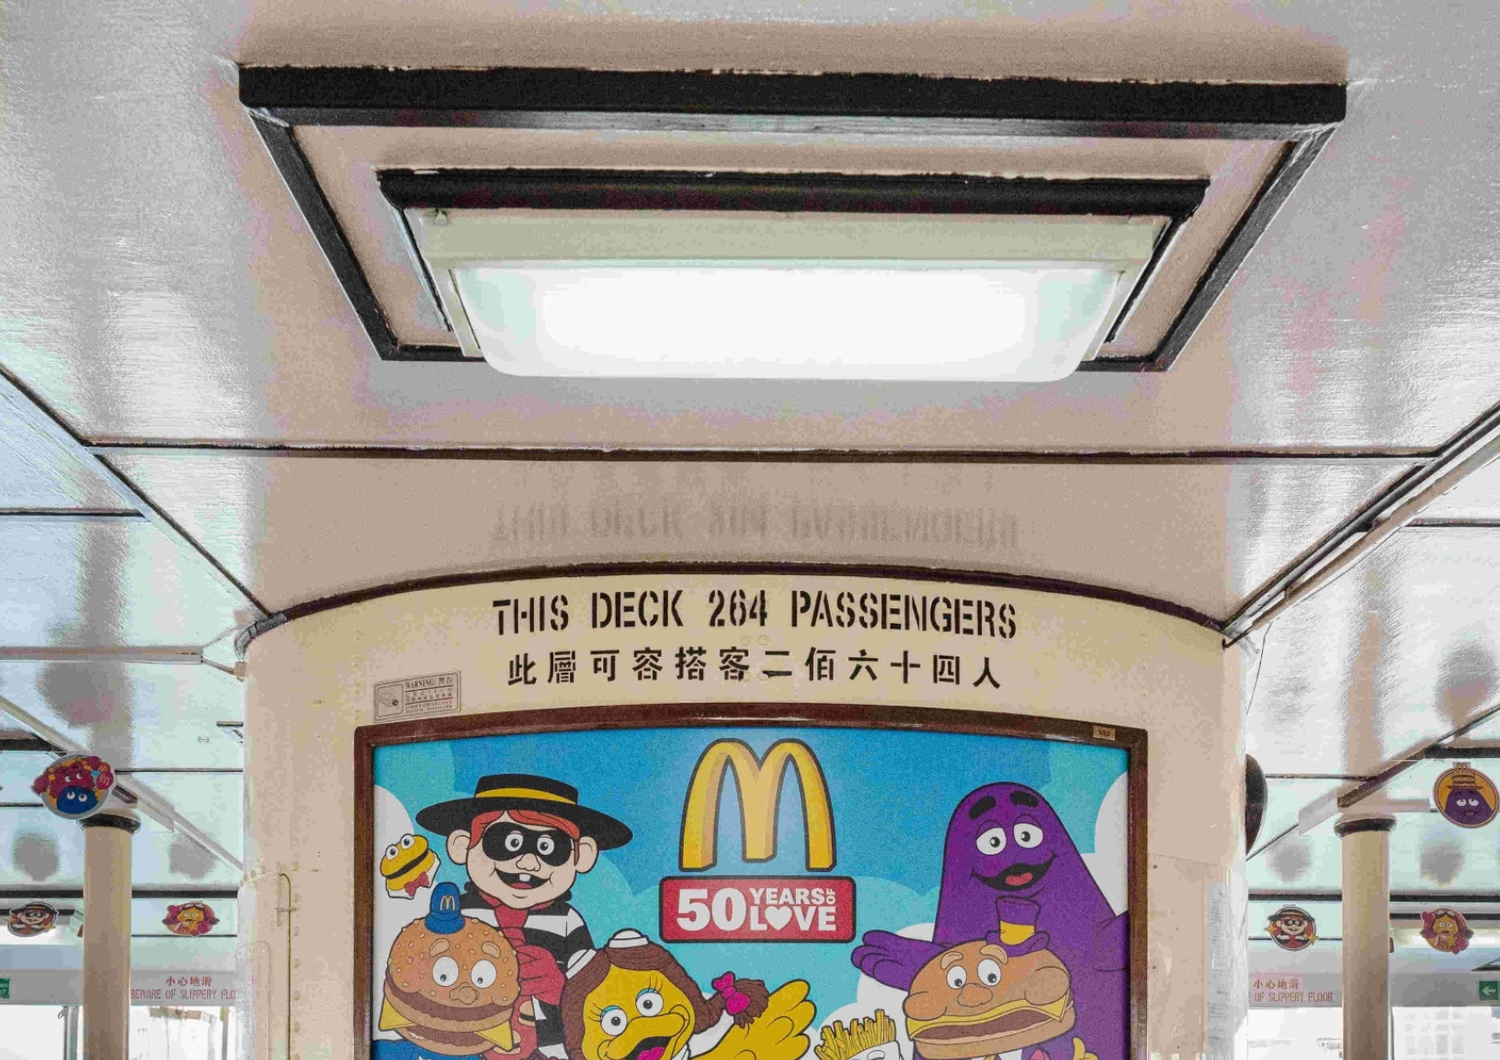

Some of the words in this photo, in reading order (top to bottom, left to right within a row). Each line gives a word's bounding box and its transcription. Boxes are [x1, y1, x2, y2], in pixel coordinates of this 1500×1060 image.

[493, 594, 569, 635] THIS
[591, 590, 684, 628] DECK
[708, 590, 767, 627] 264
[791, 590, 1017, 639] PASSENGERS
[676, 887, 747, 932] 50
[749, 887, 826, 905] YEARS
[165, 976, 213, 987] 小心地滑
[165, 989, 176, 1000] OF
[180, 989, 217, 1000] SLIPPERY
